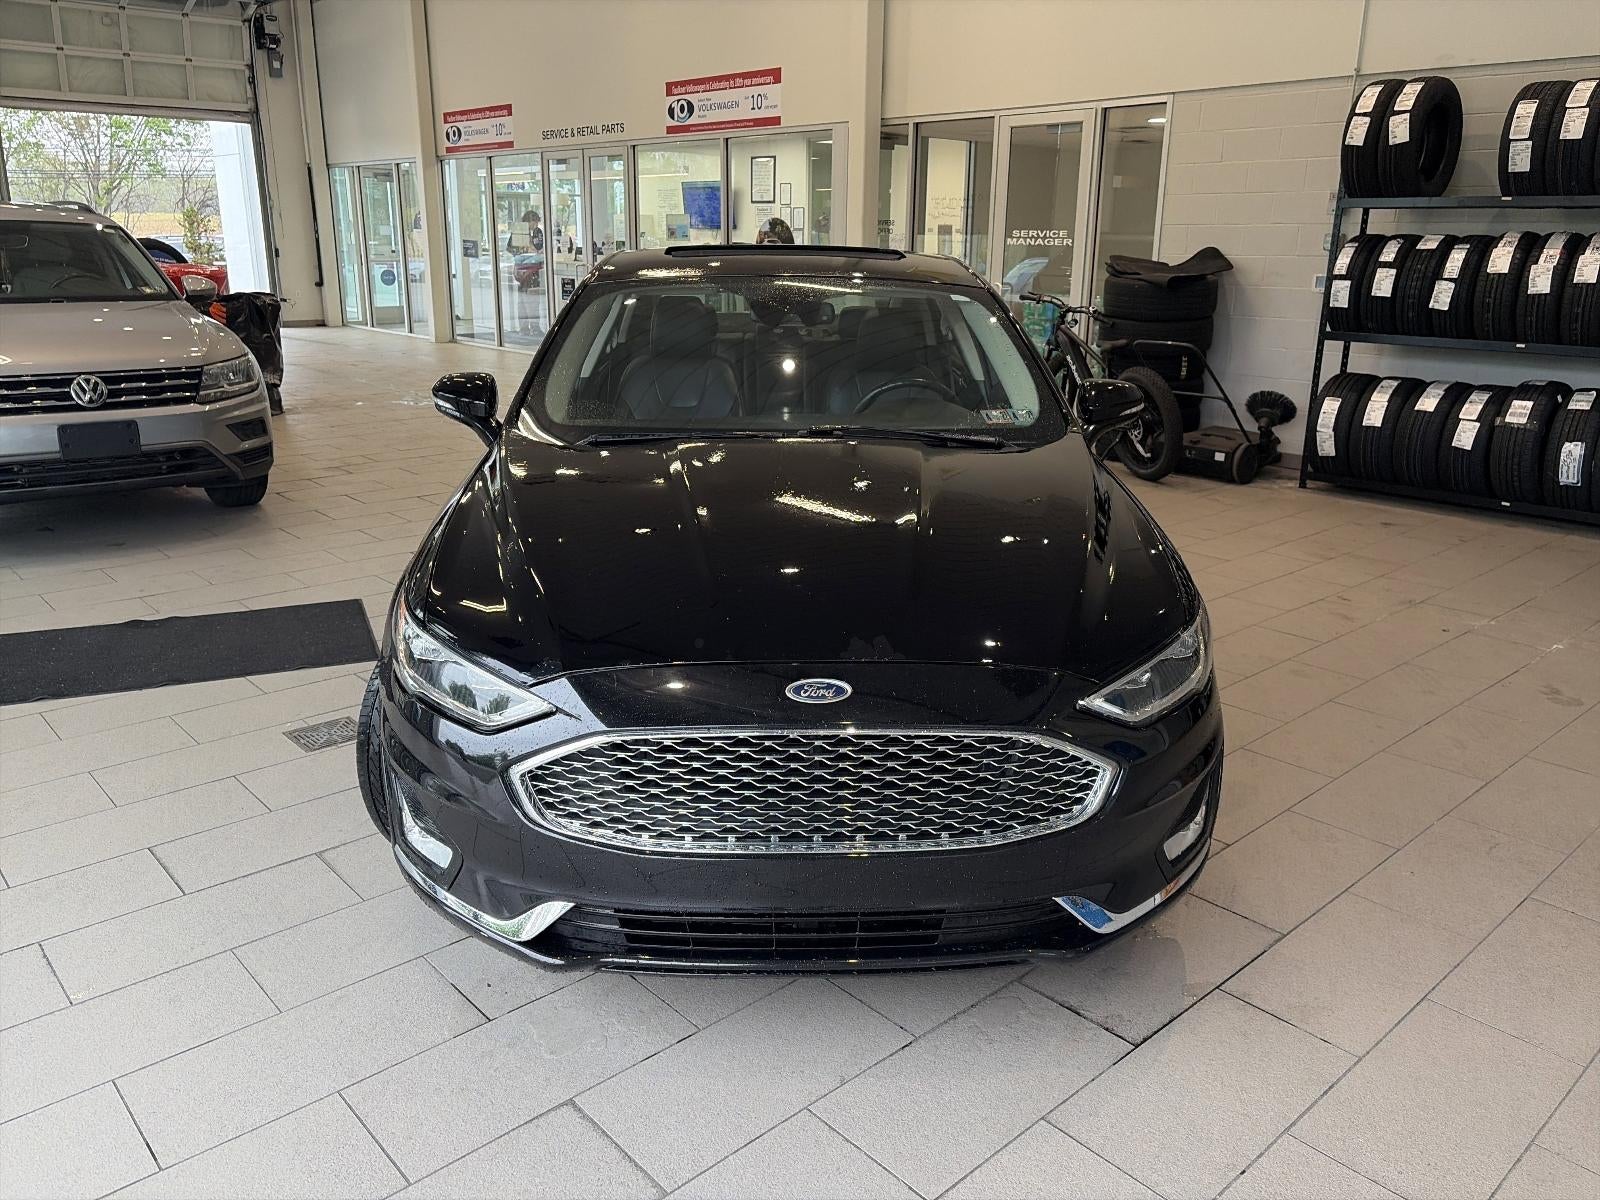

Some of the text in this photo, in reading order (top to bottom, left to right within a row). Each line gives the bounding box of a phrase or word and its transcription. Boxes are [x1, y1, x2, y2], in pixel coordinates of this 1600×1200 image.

[671, 99, 688, 122] 10
[697, 100, 739, 112] VOLKSWAGEN
[447, 126, 459, 142] 10
[541, 122, 625, 140] SERVICE & RETAIL PARTS
[1006, 237, 1073, 246] MANAGER
[1012, 230, 1069, 238] SERVICE
[800, 683, 837, 699] Ford
